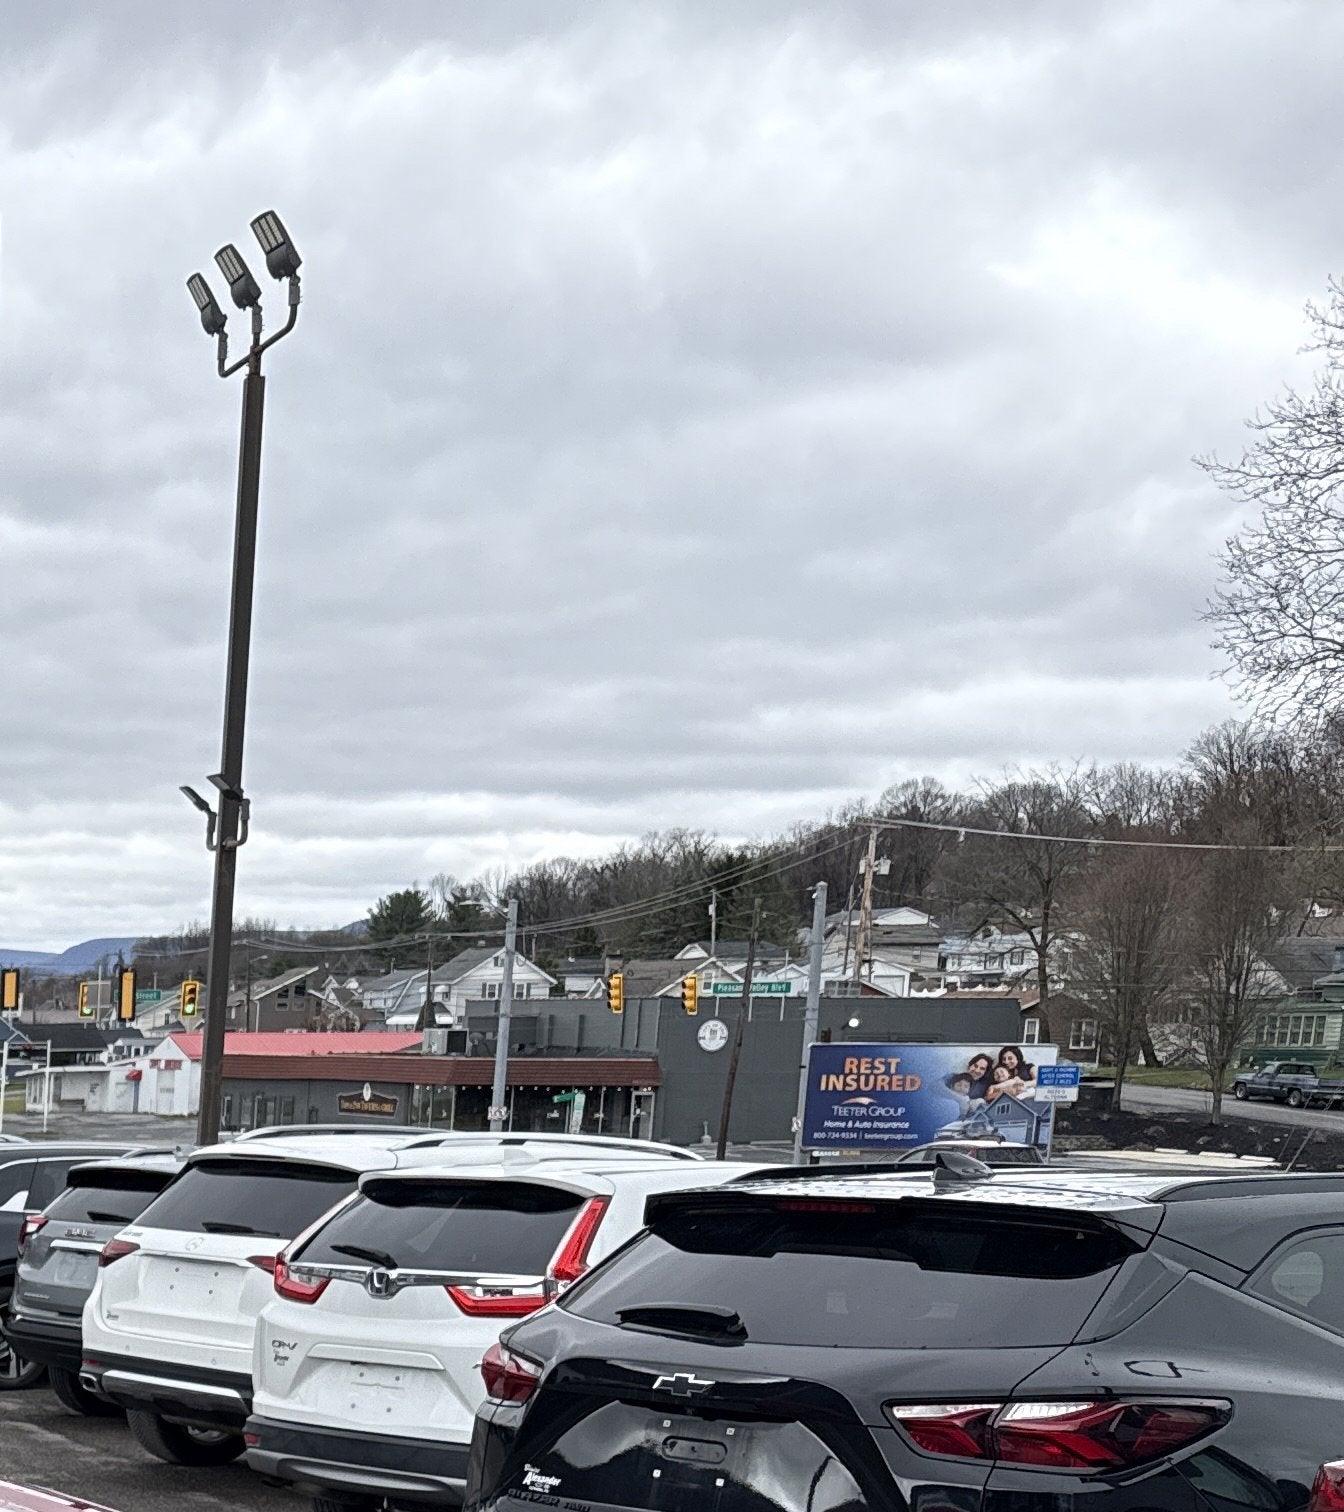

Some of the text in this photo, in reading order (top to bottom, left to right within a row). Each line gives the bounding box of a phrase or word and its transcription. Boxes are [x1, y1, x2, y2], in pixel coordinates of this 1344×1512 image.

[844, 1057, 901, 1074] REST
[820, 1074, 922, 1092] INSURED
[832, 1105, 906, 1117] TEETER GROUP
[824, 1120, 910, 1129] Home & Auto Insurance
[522, 1471, 562, 1487] Alexander
